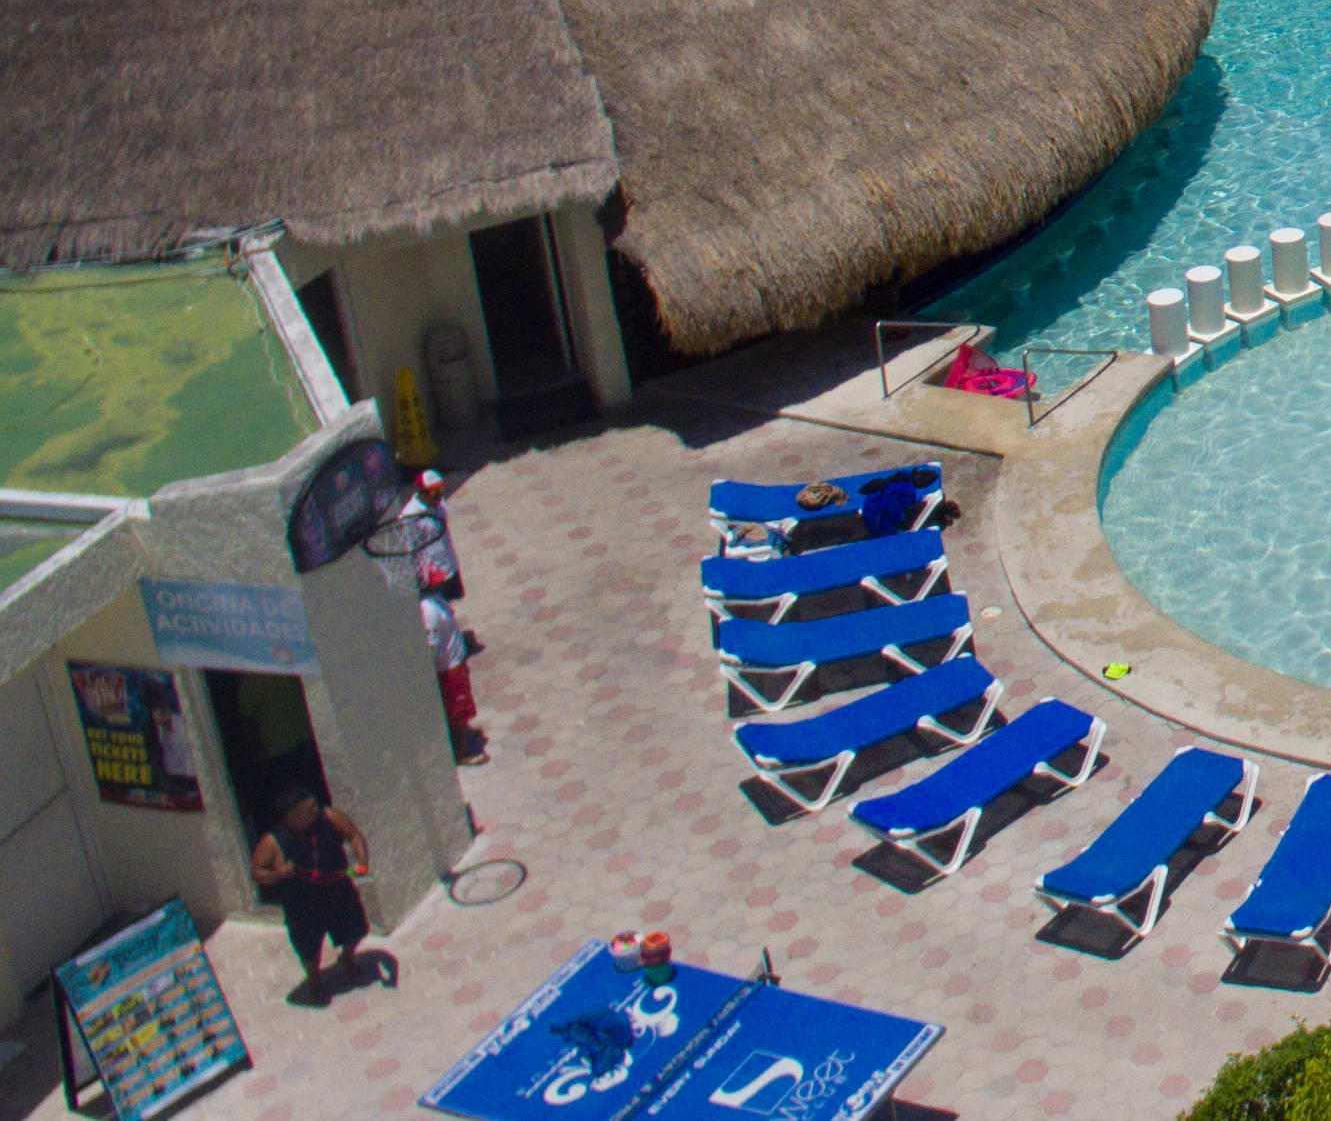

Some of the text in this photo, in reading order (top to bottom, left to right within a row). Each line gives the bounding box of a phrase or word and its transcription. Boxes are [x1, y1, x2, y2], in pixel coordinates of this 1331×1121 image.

[92, 742, 146, 761] TICKETS
[97, 761, 152, 785] HERE
[648, 1070, 692, 1115] EVERY
[693, 1019, 741, 1069] SUNDAY
